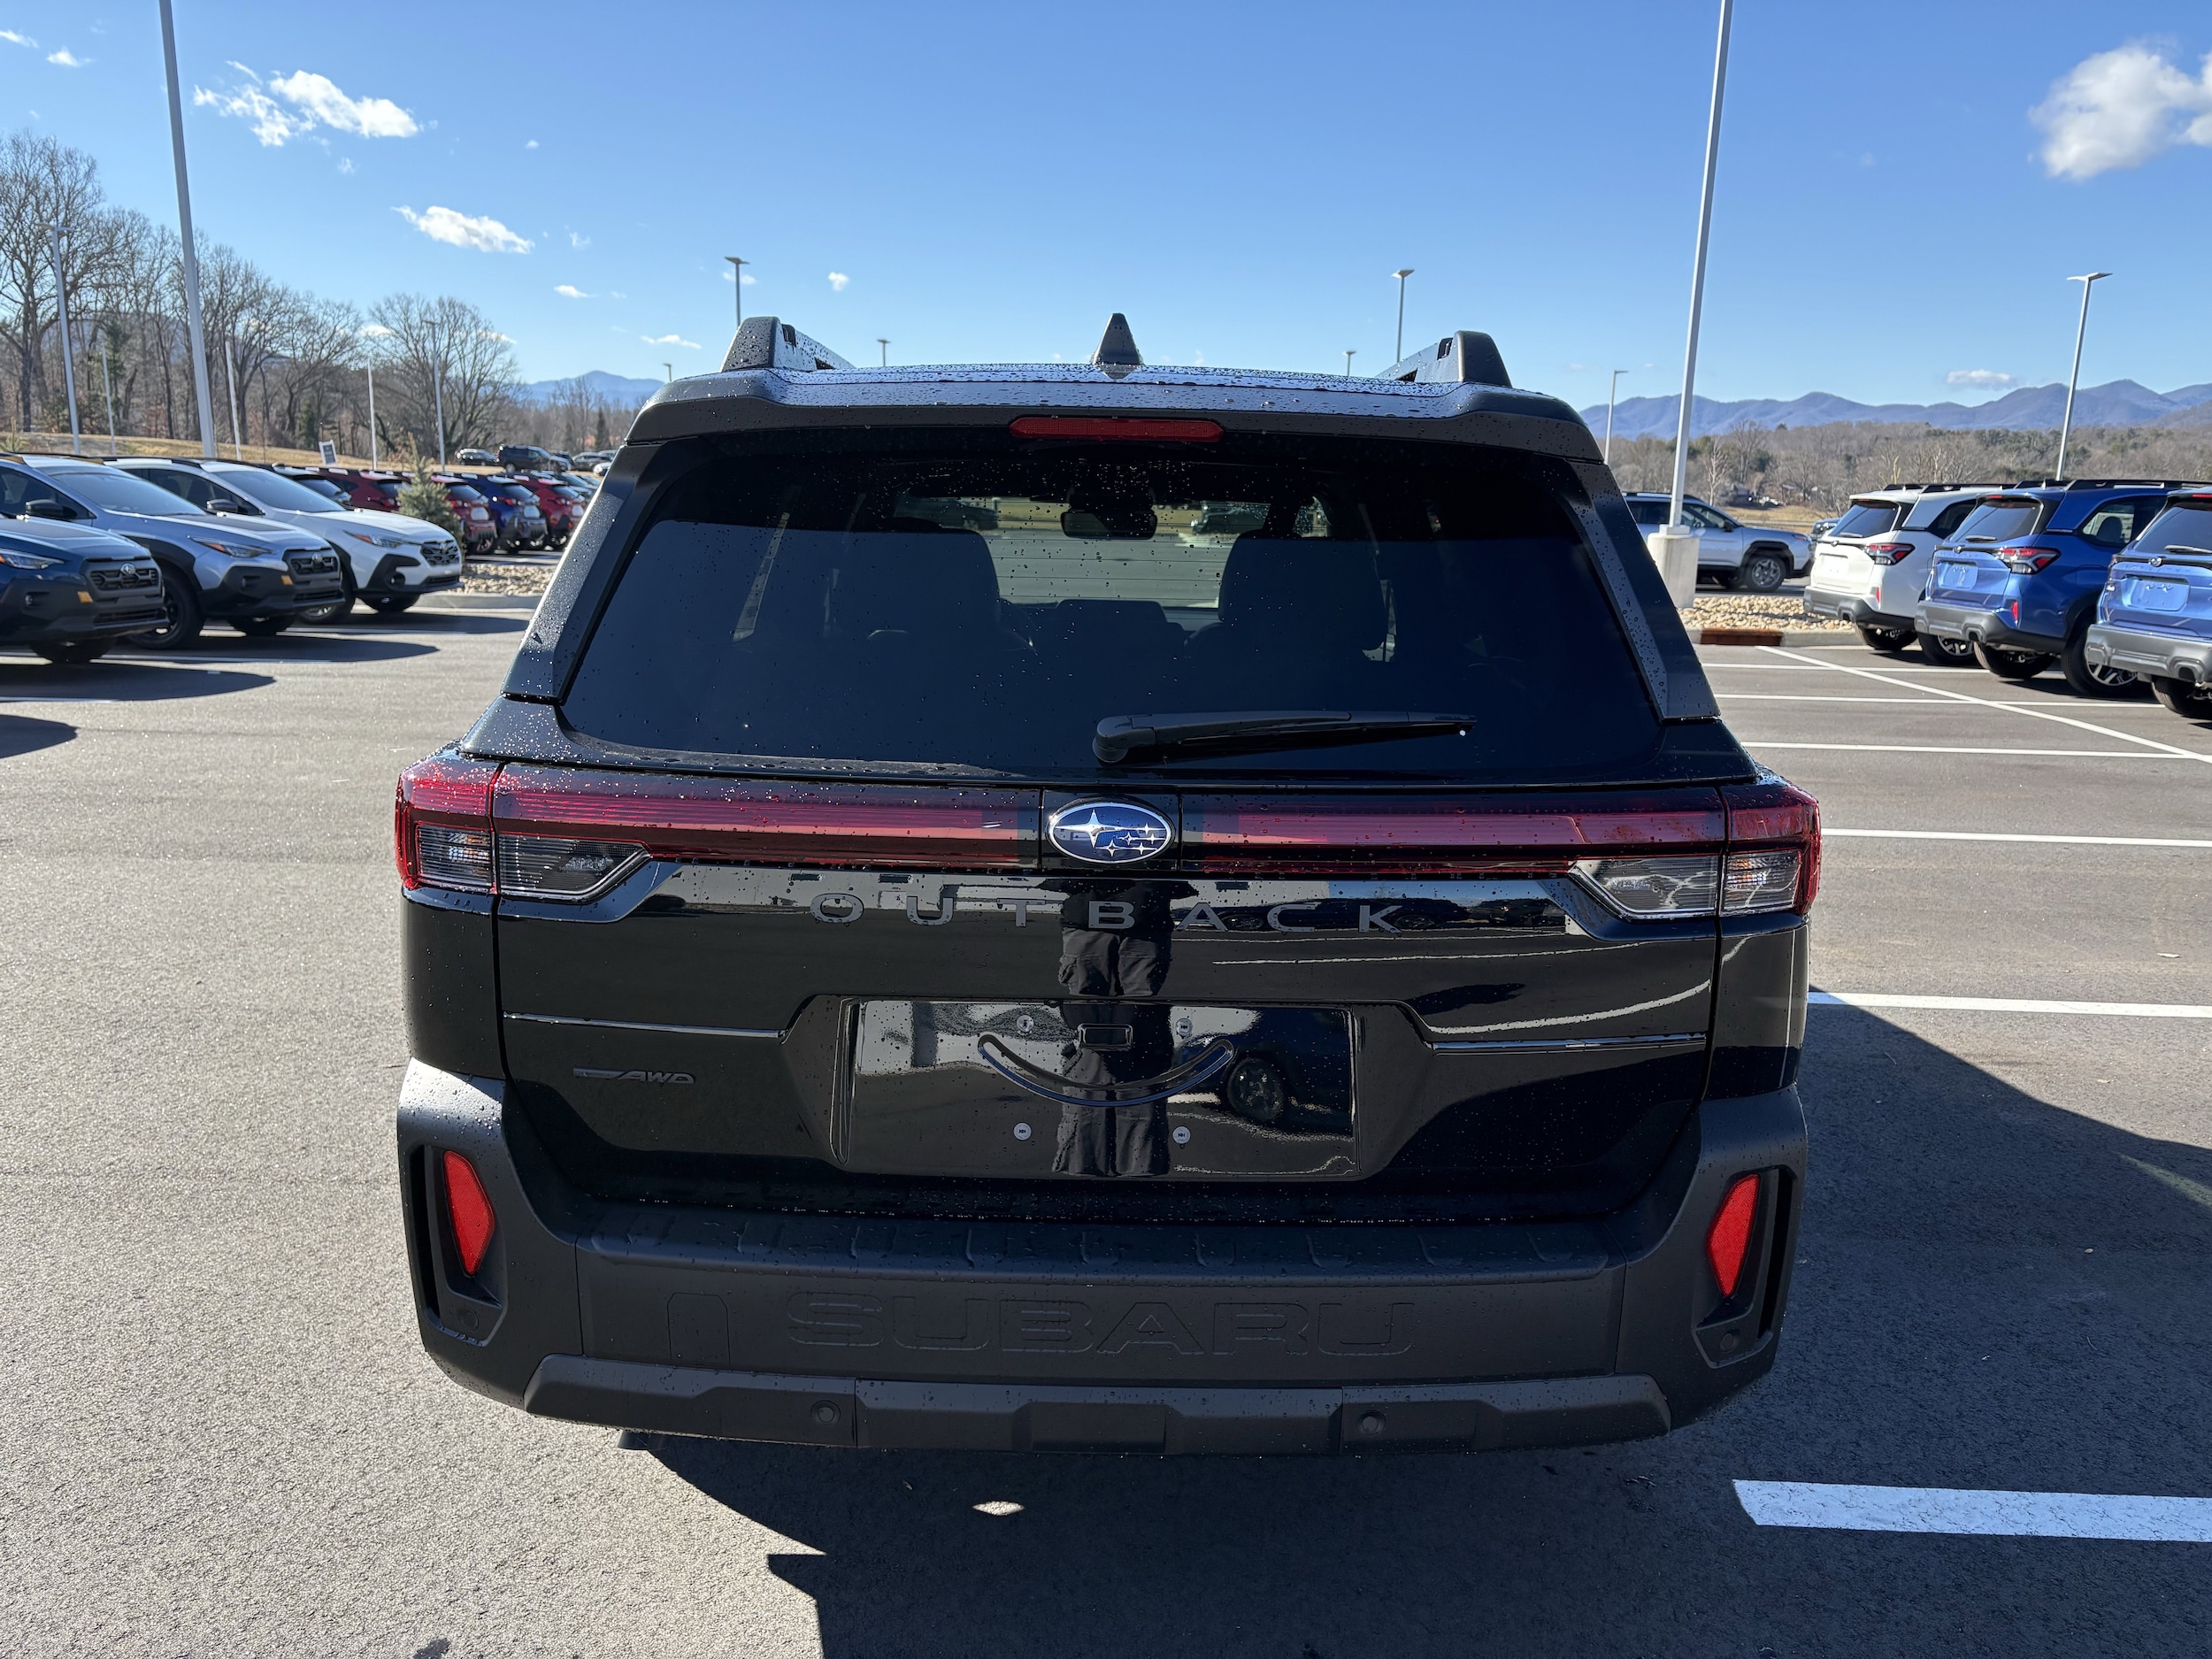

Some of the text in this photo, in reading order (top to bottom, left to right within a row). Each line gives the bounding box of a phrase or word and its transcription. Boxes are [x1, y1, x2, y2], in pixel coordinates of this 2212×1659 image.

[810, 892, 1402, 933] OUTBACK
[618, 1071, 695, 1084] AWD
[786, 1291, 1415, 1356] SUBARU
